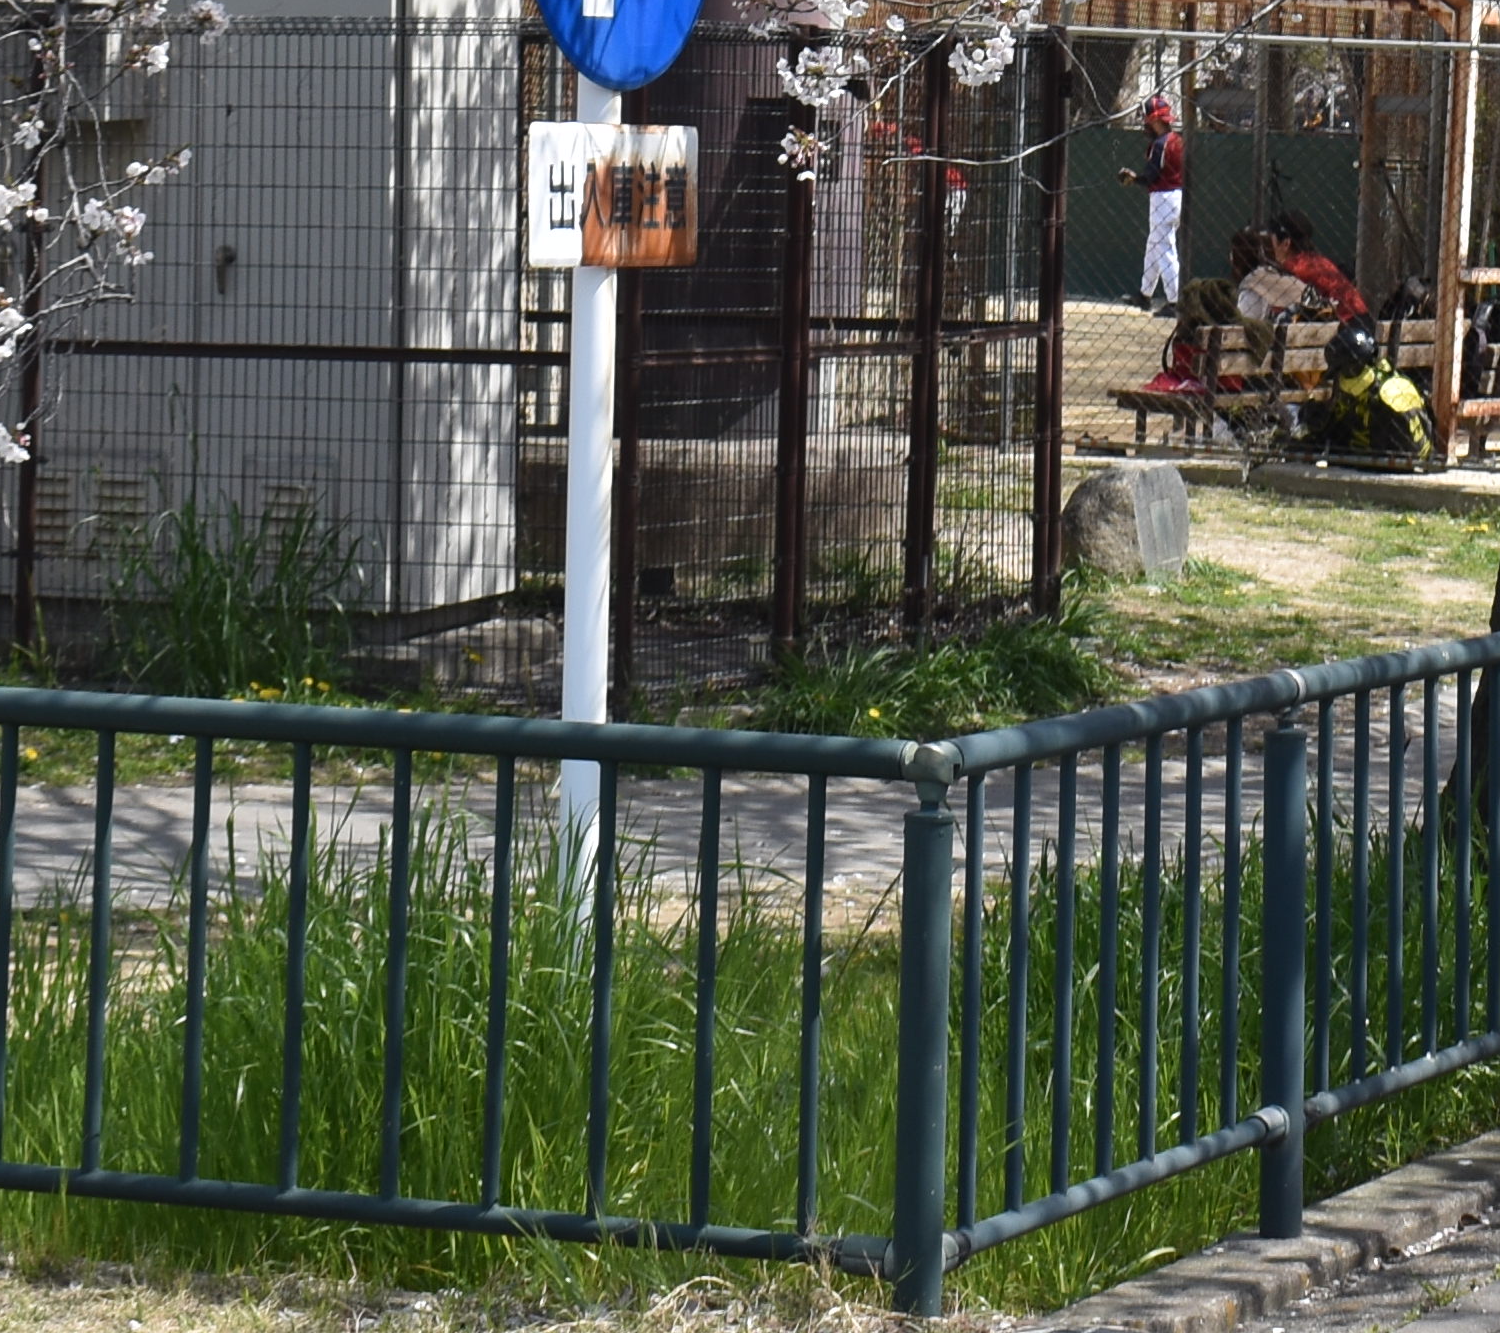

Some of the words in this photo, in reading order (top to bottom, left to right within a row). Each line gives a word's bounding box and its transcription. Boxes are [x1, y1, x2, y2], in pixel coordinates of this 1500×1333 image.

[549, 161, 687, 230] 出入庫注意
